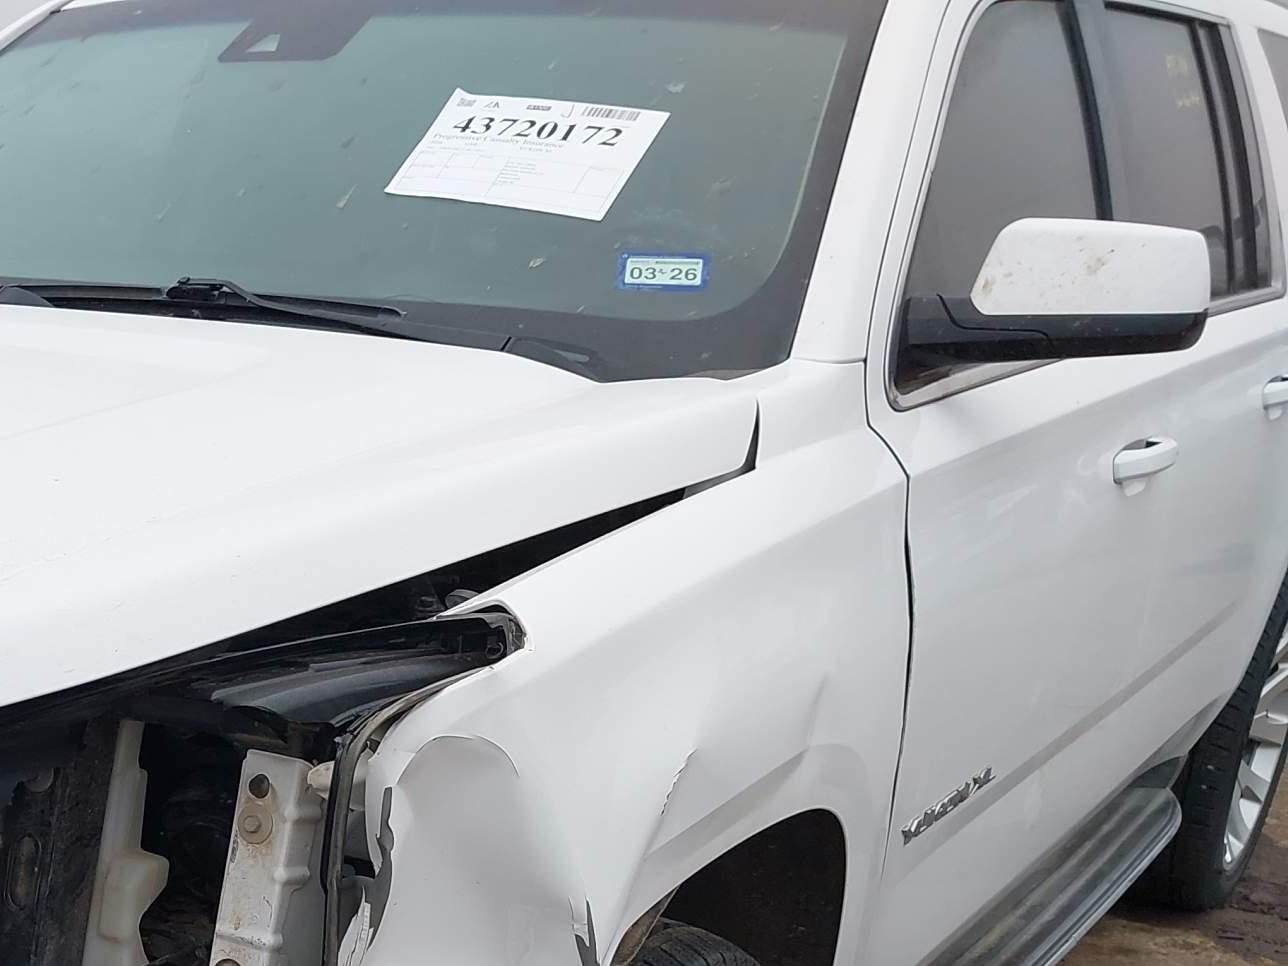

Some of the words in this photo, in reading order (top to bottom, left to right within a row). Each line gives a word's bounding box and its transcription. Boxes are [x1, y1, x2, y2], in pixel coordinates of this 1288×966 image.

[453, 115, 623, 147] 43720172
[629, 266, 657, 280] 03
[669, 267, 698, 281] 26
